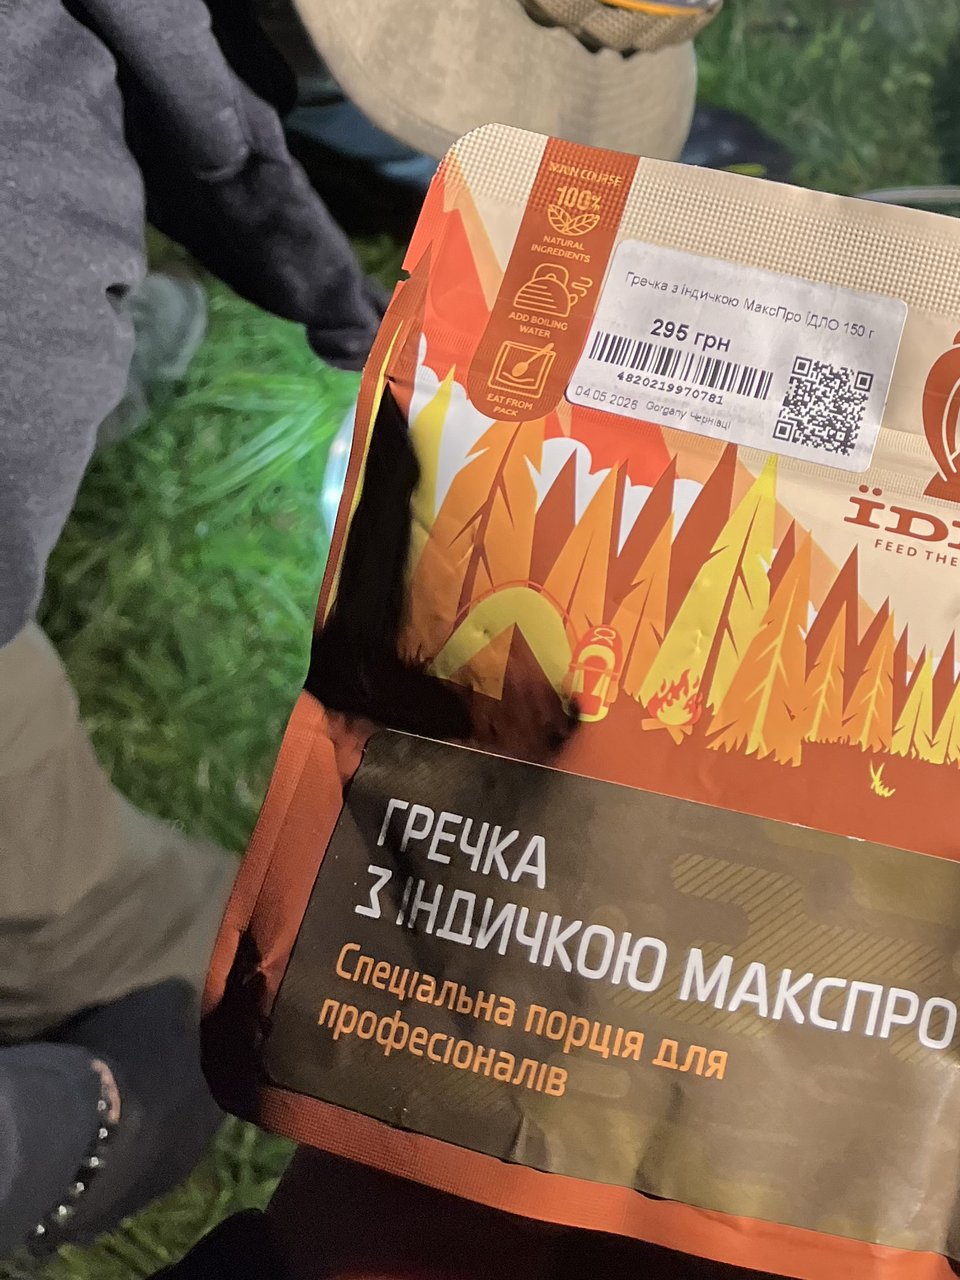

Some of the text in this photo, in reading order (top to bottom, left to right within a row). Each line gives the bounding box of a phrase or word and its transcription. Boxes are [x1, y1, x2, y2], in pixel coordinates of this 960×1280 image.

[556, 185, 602, 212] 100%
[531, 244, 590, 263] INGREDIENTS
[543, 235, 585, 250] NATURAL
[625, 271, 668, 291] Гречка
[671, 284, 679, 294] з
[680, 283, 739, 307] індичкою
[743, 298, 802, 322] МаксПро
[843, 322, 866, 337] 150
[869, 329, 875, 339] г
[508, 311, 568, 331] ADD BOILING
[519, 325, 551, 338] WATER
[650, 318, 731, 352] 295 грн
[487, 393, 533, 410] EAT FROM
[617, 371, 724, 405] 4820219970781
[493, 406, 518, 416] PACK
[645, 401, 687, 420] Gorgany
[874, 538, 917, 558] FEED
[924, 549, 958, 568] THE
[376, 798, 546, 889] ГРЕЧКА
[354, 864, 958, 1050] З ІНДИЧКОЮ МАКСПРО
[335, 942, 729, 1081] Спеціальна порція для
[318, 998, 569, 1097] професіоналів
